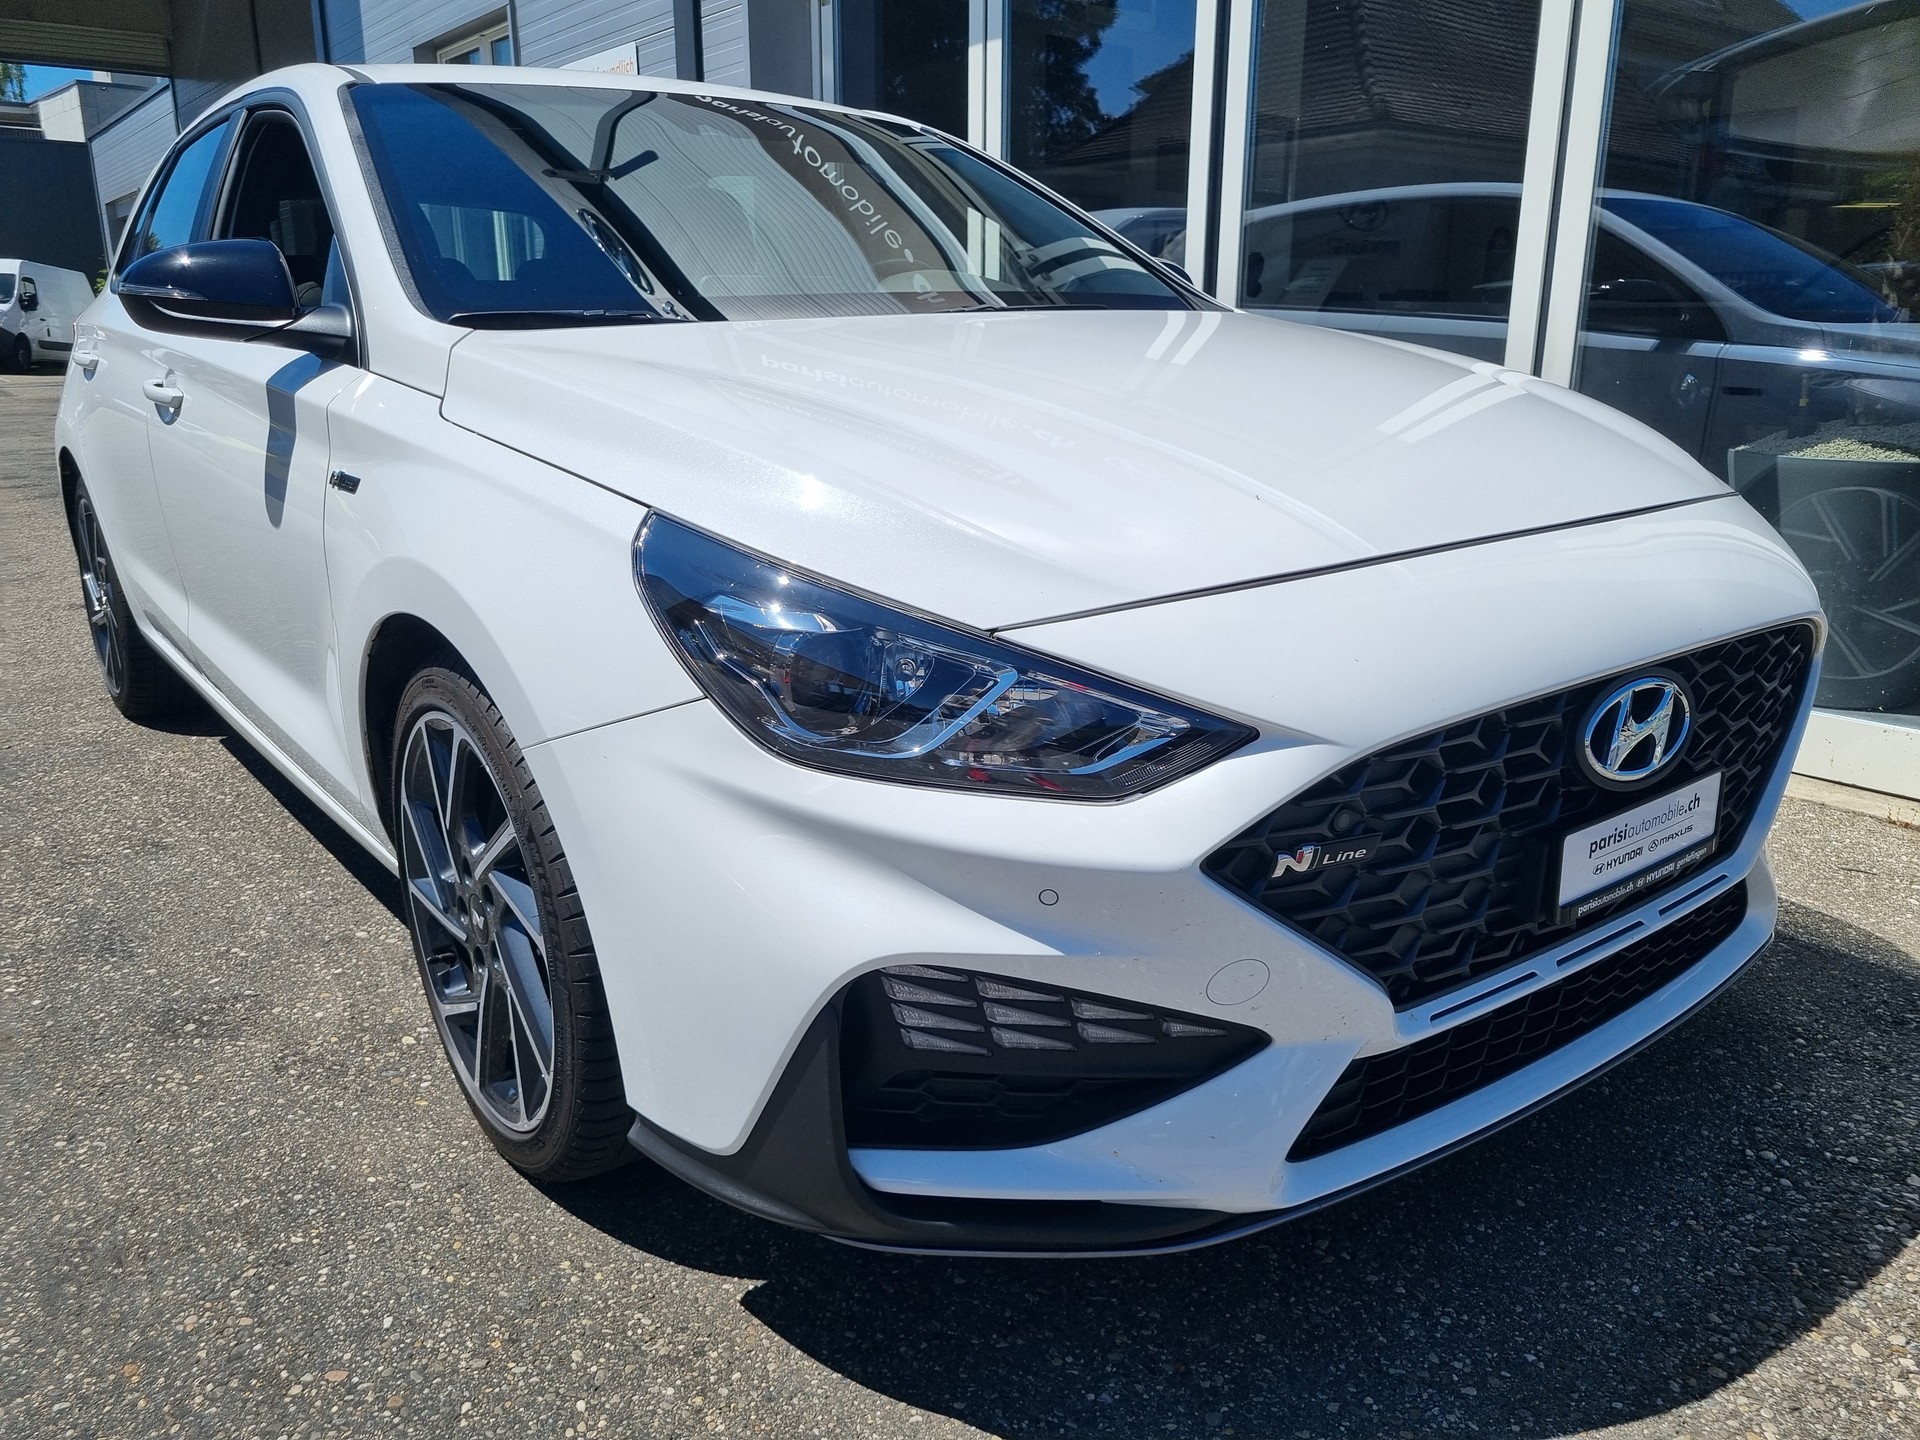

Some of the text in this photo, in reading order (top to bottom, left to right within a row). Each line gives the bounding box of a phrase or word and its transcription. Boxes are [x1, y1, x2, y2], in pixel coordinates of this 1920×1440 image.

[1589, 792, 1701, 859] parisiautomobile.ch
[1322, 848, 1367, 865] Line
[1606, 846, 1644, 871] HYUNDAI
[1578, 882, 1634, 917] parisiautomobile.ch
[1646, 862, 1675, 883] HYUNDAI
